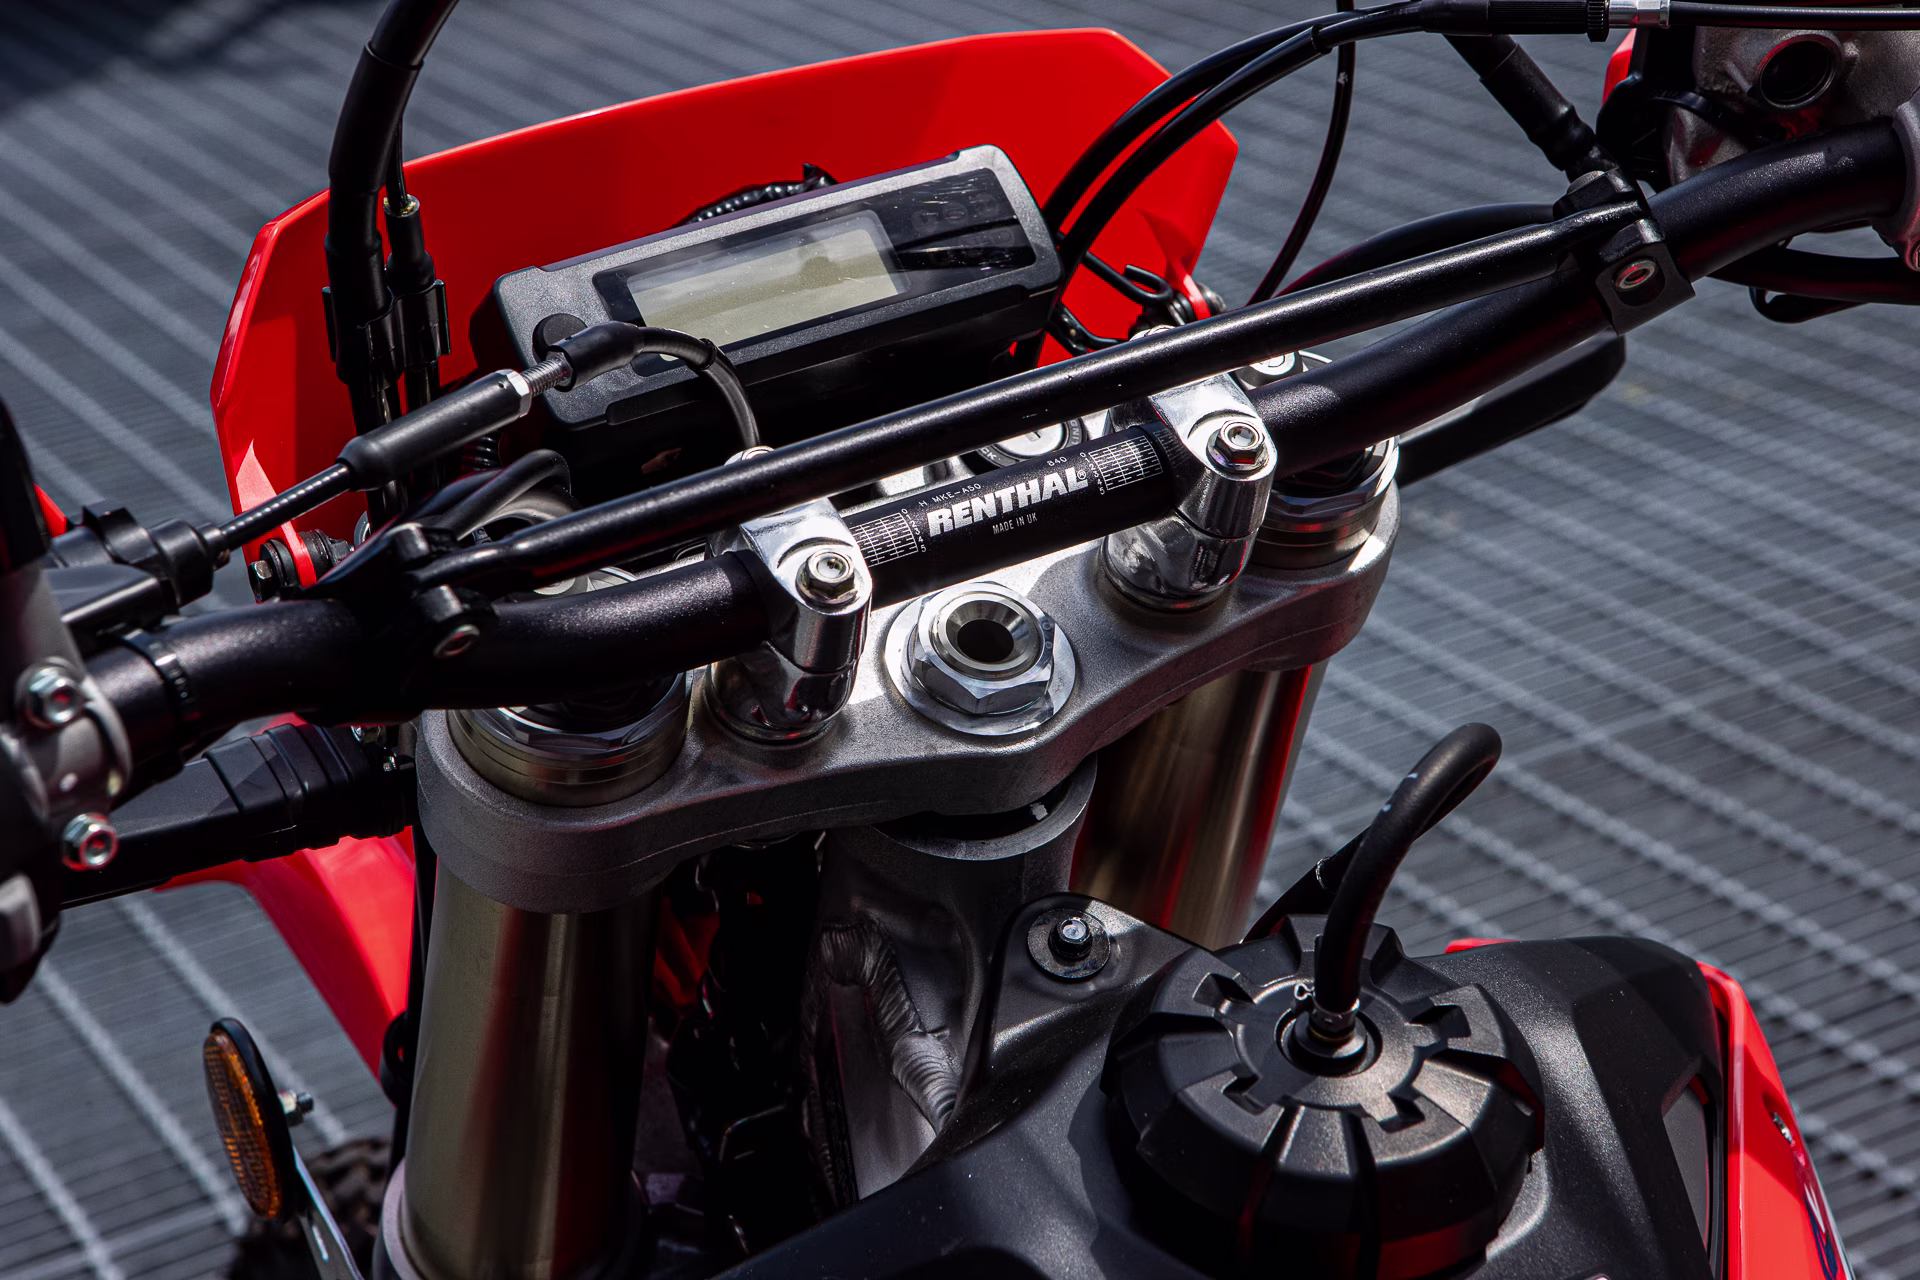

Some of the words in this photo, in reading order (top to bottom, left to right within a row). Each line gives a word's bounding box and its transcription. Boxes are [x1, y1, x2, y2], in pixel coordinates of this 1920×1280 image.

[931, 483, 981, 503] MKE-A50
[992, 519, 1015, 535] MADE
[1016, 515, 1026, 527] IN
[1027, 512, 1038, 524] UK
